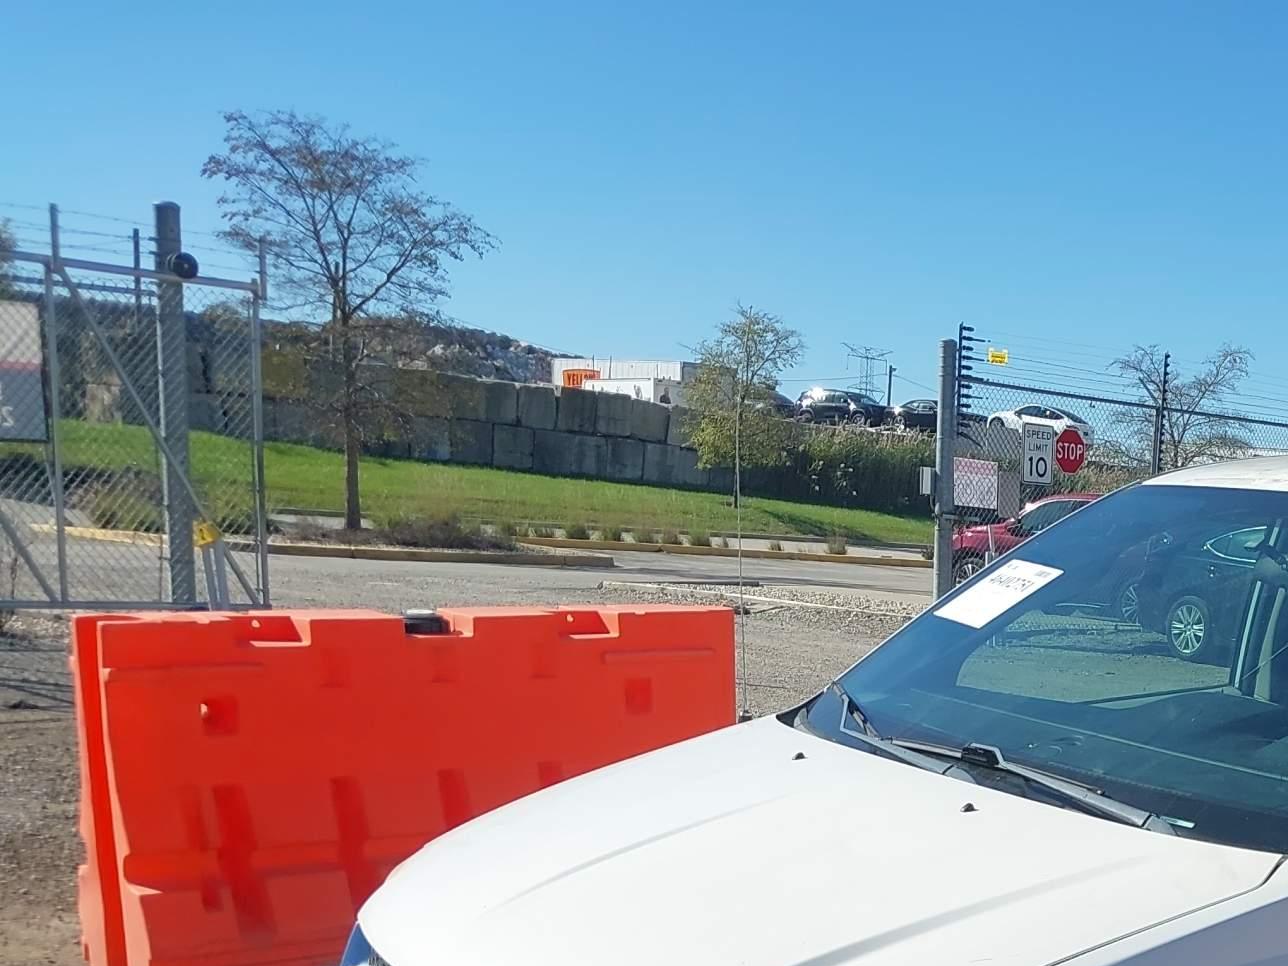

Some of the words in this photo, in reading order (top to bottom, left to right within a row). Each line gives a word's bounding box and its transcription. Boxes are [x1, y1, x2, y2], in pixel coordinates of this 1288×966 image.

[1026, 429, 1052, 441] SPEED
[1028, 441, 1049, 454] LIMIT
[1056, 441, 1084, 461] STOP
[1028, 455, 1048, 478] 10
